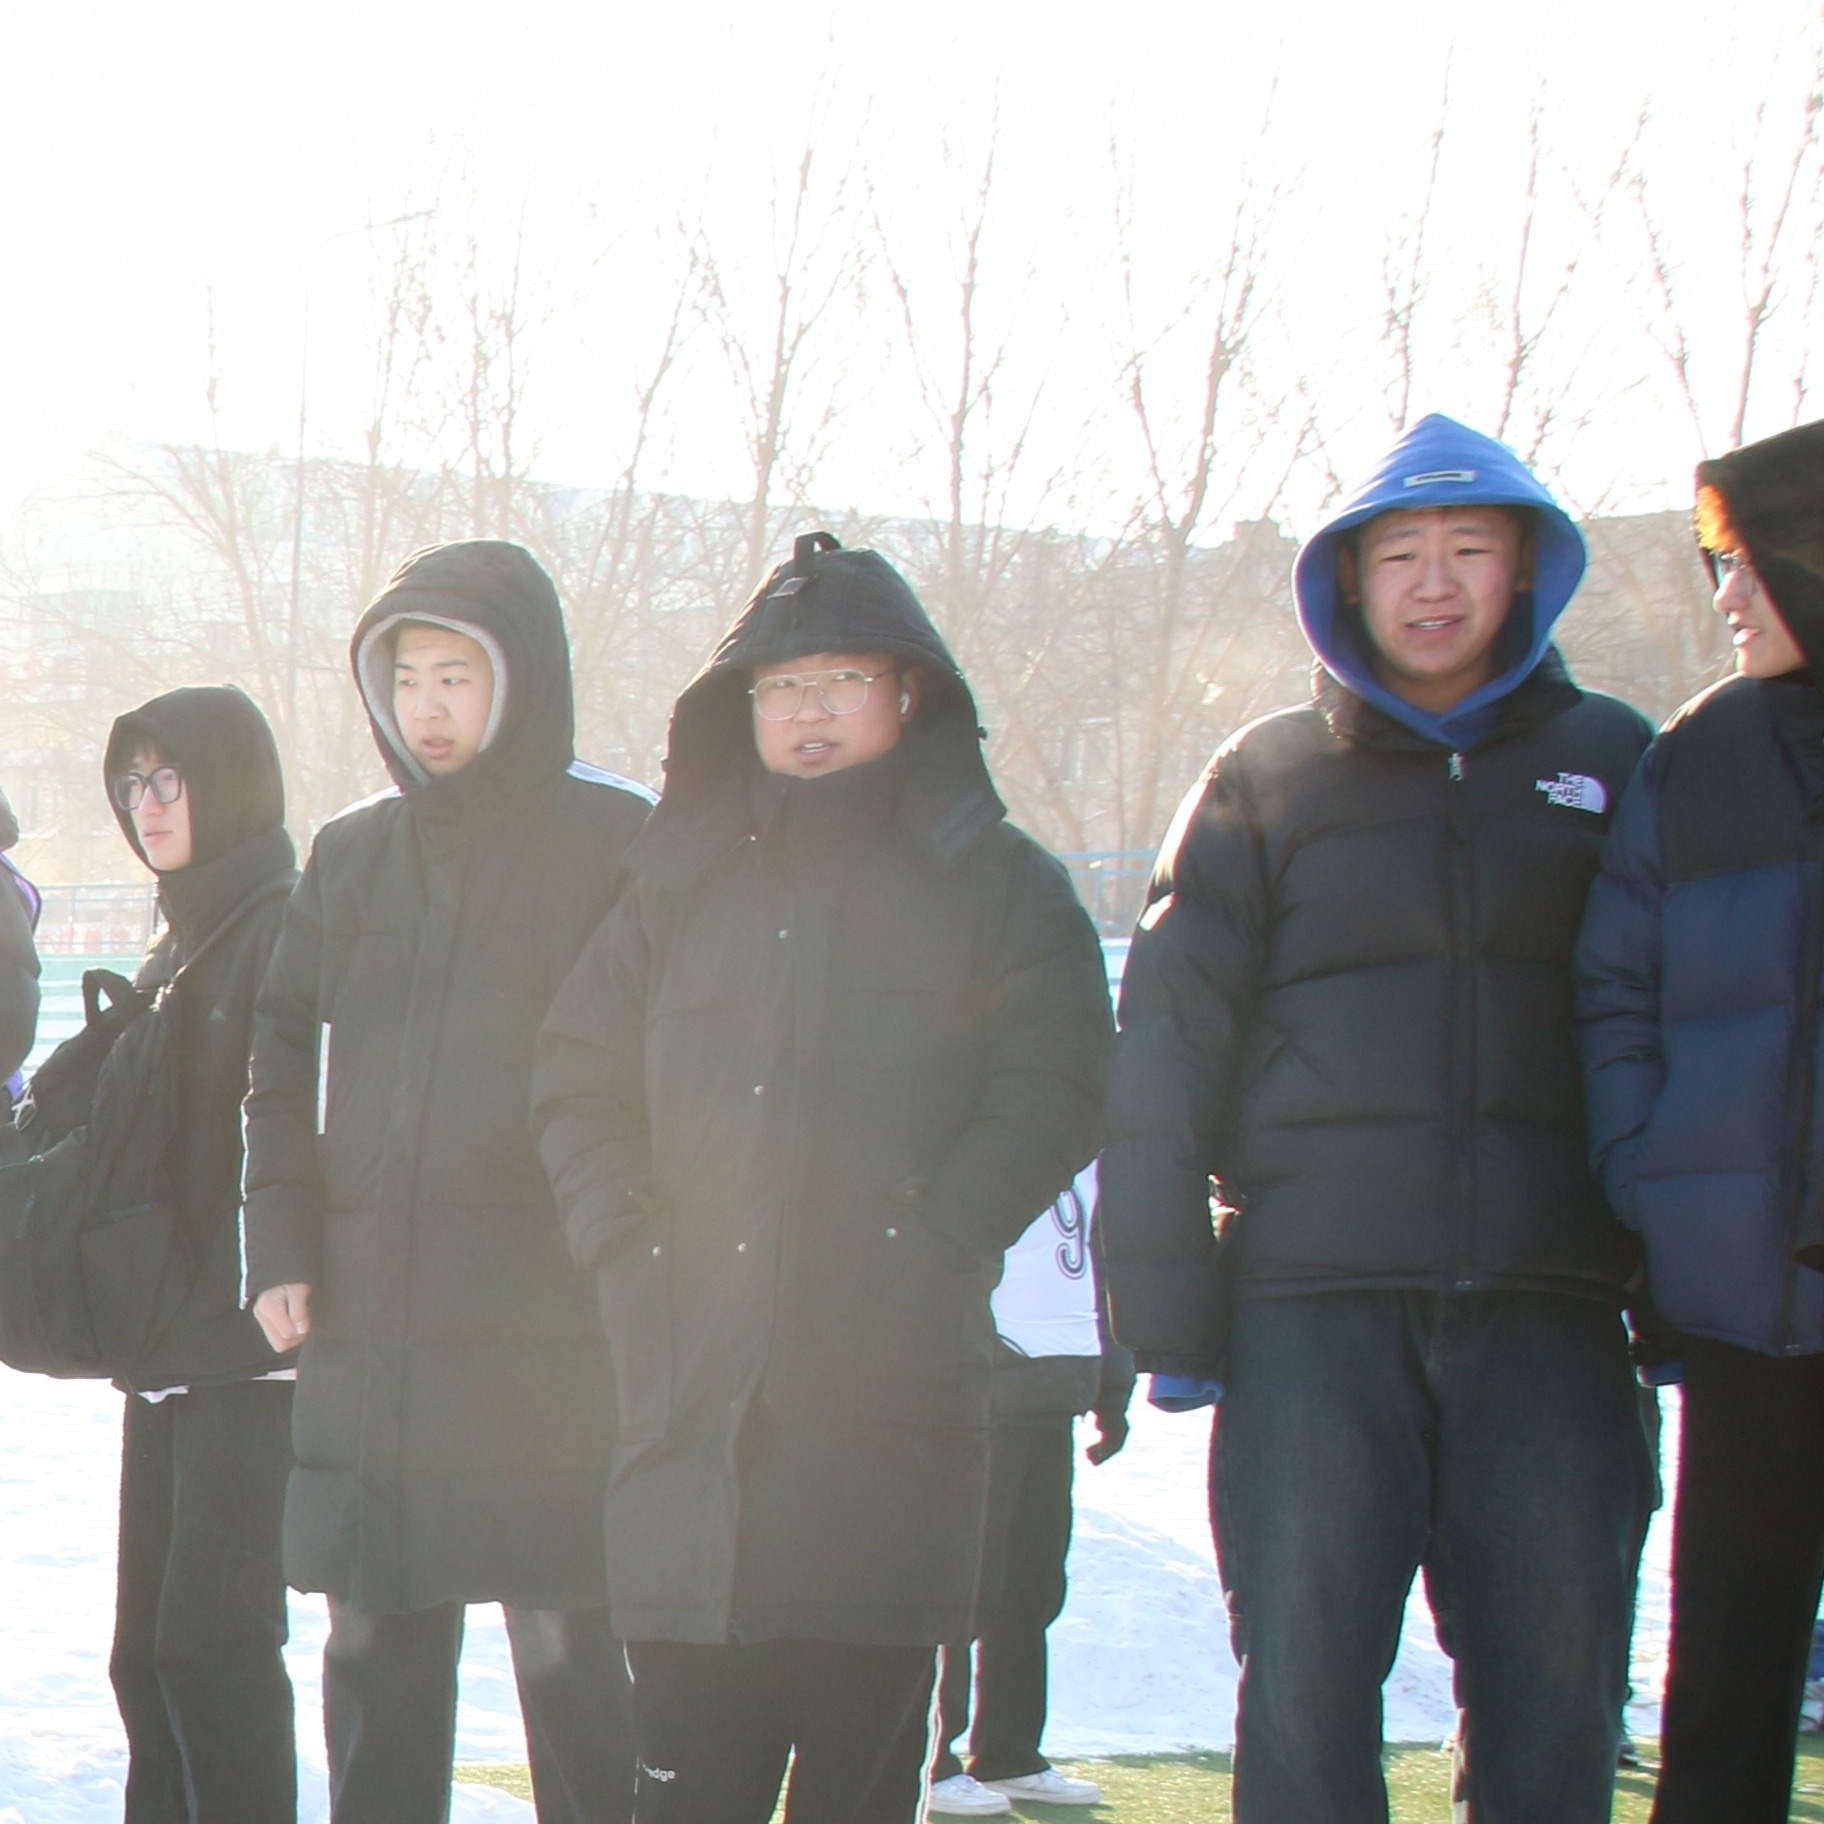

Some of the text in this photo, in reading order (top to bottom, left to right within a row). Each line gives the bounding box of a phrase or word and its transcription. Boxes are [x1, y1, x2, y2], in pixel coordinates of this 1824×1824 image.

[1557, 772, 1584, 785] THE
[1535, 780, 1583, 797] NORTH
[1547, 791, 1582, 809] FACE
[1049, 1188, 1087, 1281] 9
